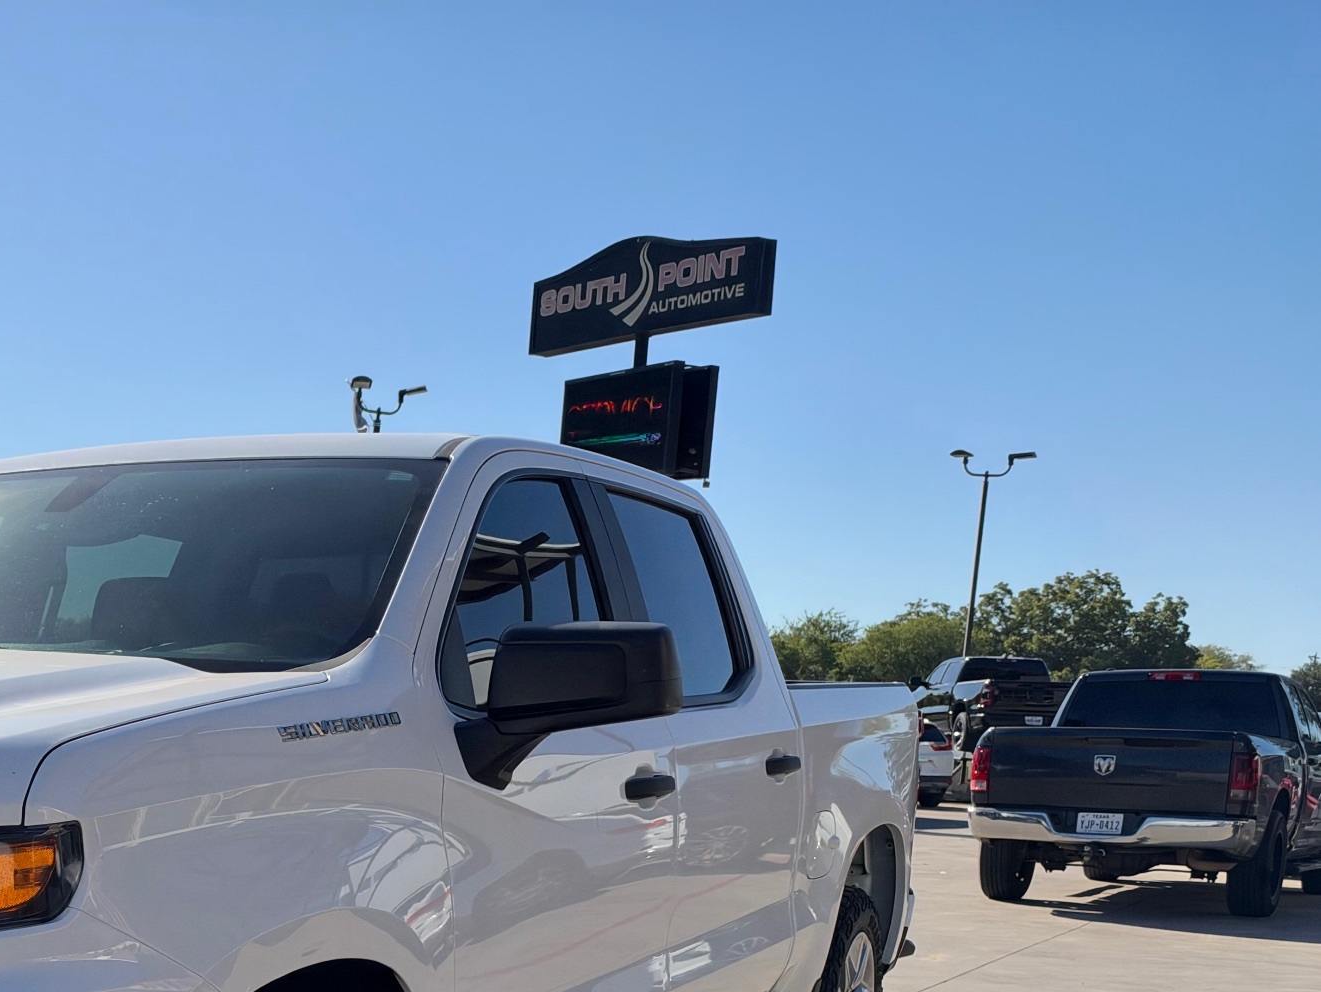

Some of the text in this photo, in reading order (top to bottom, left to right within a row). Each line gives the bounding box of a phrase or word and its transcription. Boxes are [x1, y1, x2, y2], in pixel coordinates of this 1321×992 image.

[540, 245, 746, 317] SOUTH POINT
[648, 282, 745, 315] AUTOMOTIVE
[276, 711, 402, 743] SILVERADO
